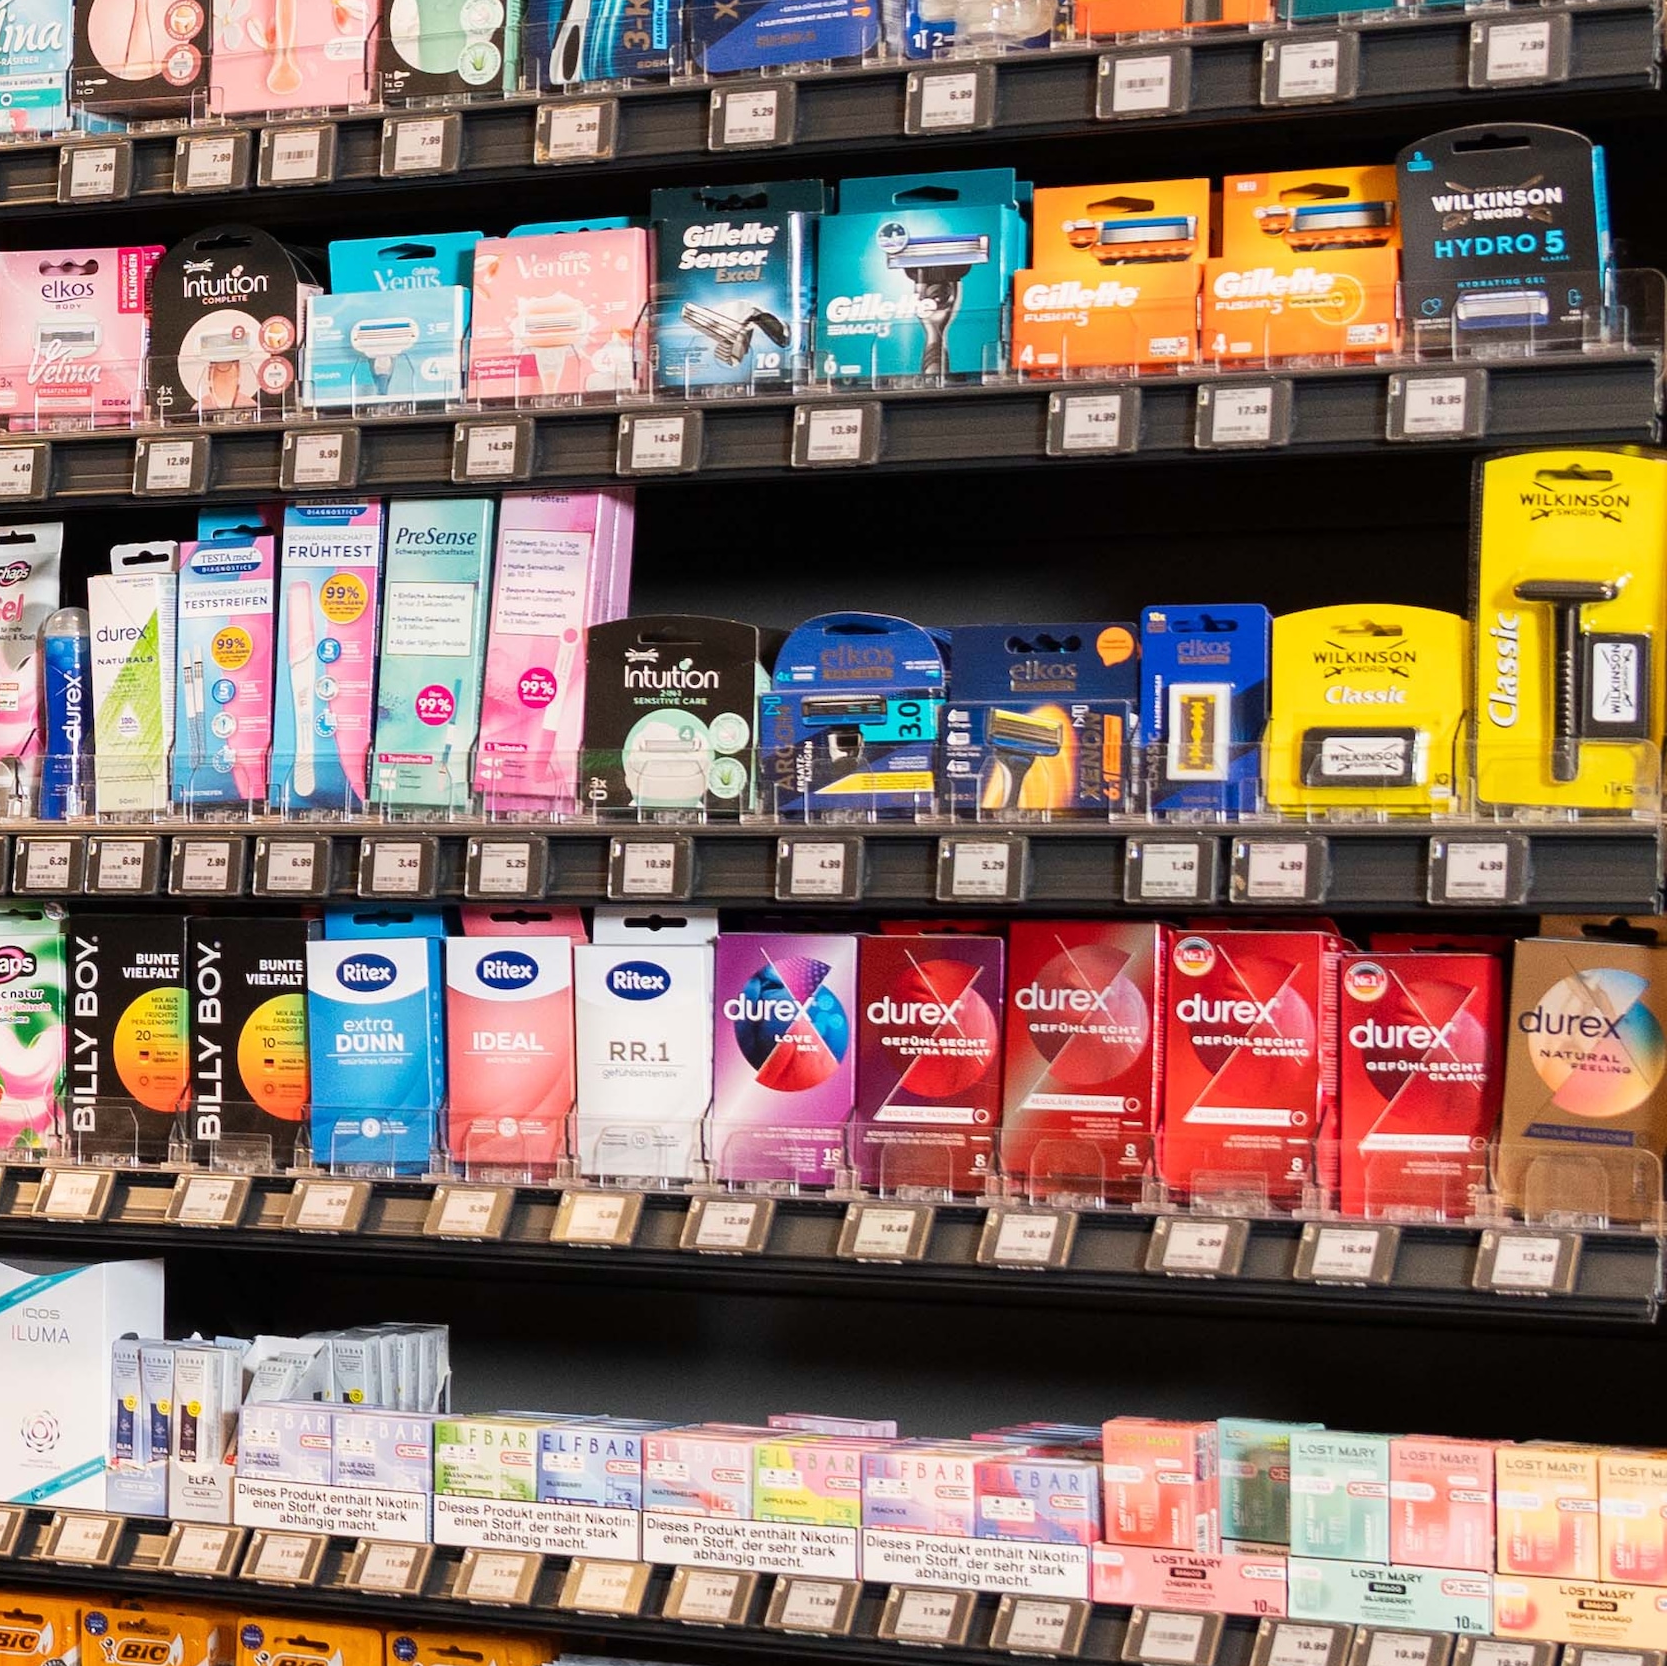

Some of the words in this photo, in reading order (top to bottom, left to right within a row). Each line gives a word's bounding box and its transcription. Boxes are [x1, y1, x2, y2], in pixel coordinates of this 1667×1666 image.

[93, 160, 114, 174] 7.99
[1431, 186, 1563, 212] WILKINSON
[683, 224, 776, 249] Gillette
[1435, 233, 1536, 260] HYDRO
[1545, 231, 1564, 254] 5
[679, 247, 767, 271] Sensor
[183, 268, 267, 299] Intuition
[1214, 270, 1336, 299] Gillette
[827, 295, 934, 323] Gillette
[1519, 492, 1631, 510] WILKINSON
[288, 540, 373, 560] FRÜHTEST
[396, 527, 478, 549] PreSense
[183, 594, 268, 612] TESTSTREIFEN
[98, 624, 147, 644] durex
[1313, 650, 1417, 668] WILKINSON
[1488, 609, 1519, 729] Classic
[62, 670, 83, 741] durex
[1324, 684, 1408, 705] Classic
[136, 952, 179, 968] BUNTE
[342, 958, 392, 985] Ritex
[481, 956, 533, 983] Ritex
[122, 965, 179, 981] VIELFALT
[613, 966, 665, 993] Ritex
[724, 993, 813, 1022] durex
[867, 996, 960, 1027] durex
[1176, 994, 1278, 1025] durex
[1519, 1005, 1625, 1039] durex
[336, 1029, 404, 1052] DÜNN
[472, 1030, 544, 1052] IDEAL
[1349, 1019, 1453, 1051] durex
[609, 1039, 671, 1063] RR.1
[72, 1030, 98, 1132] BILLY
[237, 1483, 276, 1496] Dieses
[279, 1487, 325, 1501] Produkt
[329, 1490, 372, 1505] enthält
[375, 1497, 425, 1512] Nikotin:
[252, 1500, 287, 1513] einen
[290, 1502, 322, 1515] Stoff,
[325, 1505, 347, 1517] der
[350, 1508, 375, 1520] sehr
[379, 1510, 408, 1524] stark
[279, 1512, 335, 1529] abhängig
[339, 1518, 379, 1532] macht.
